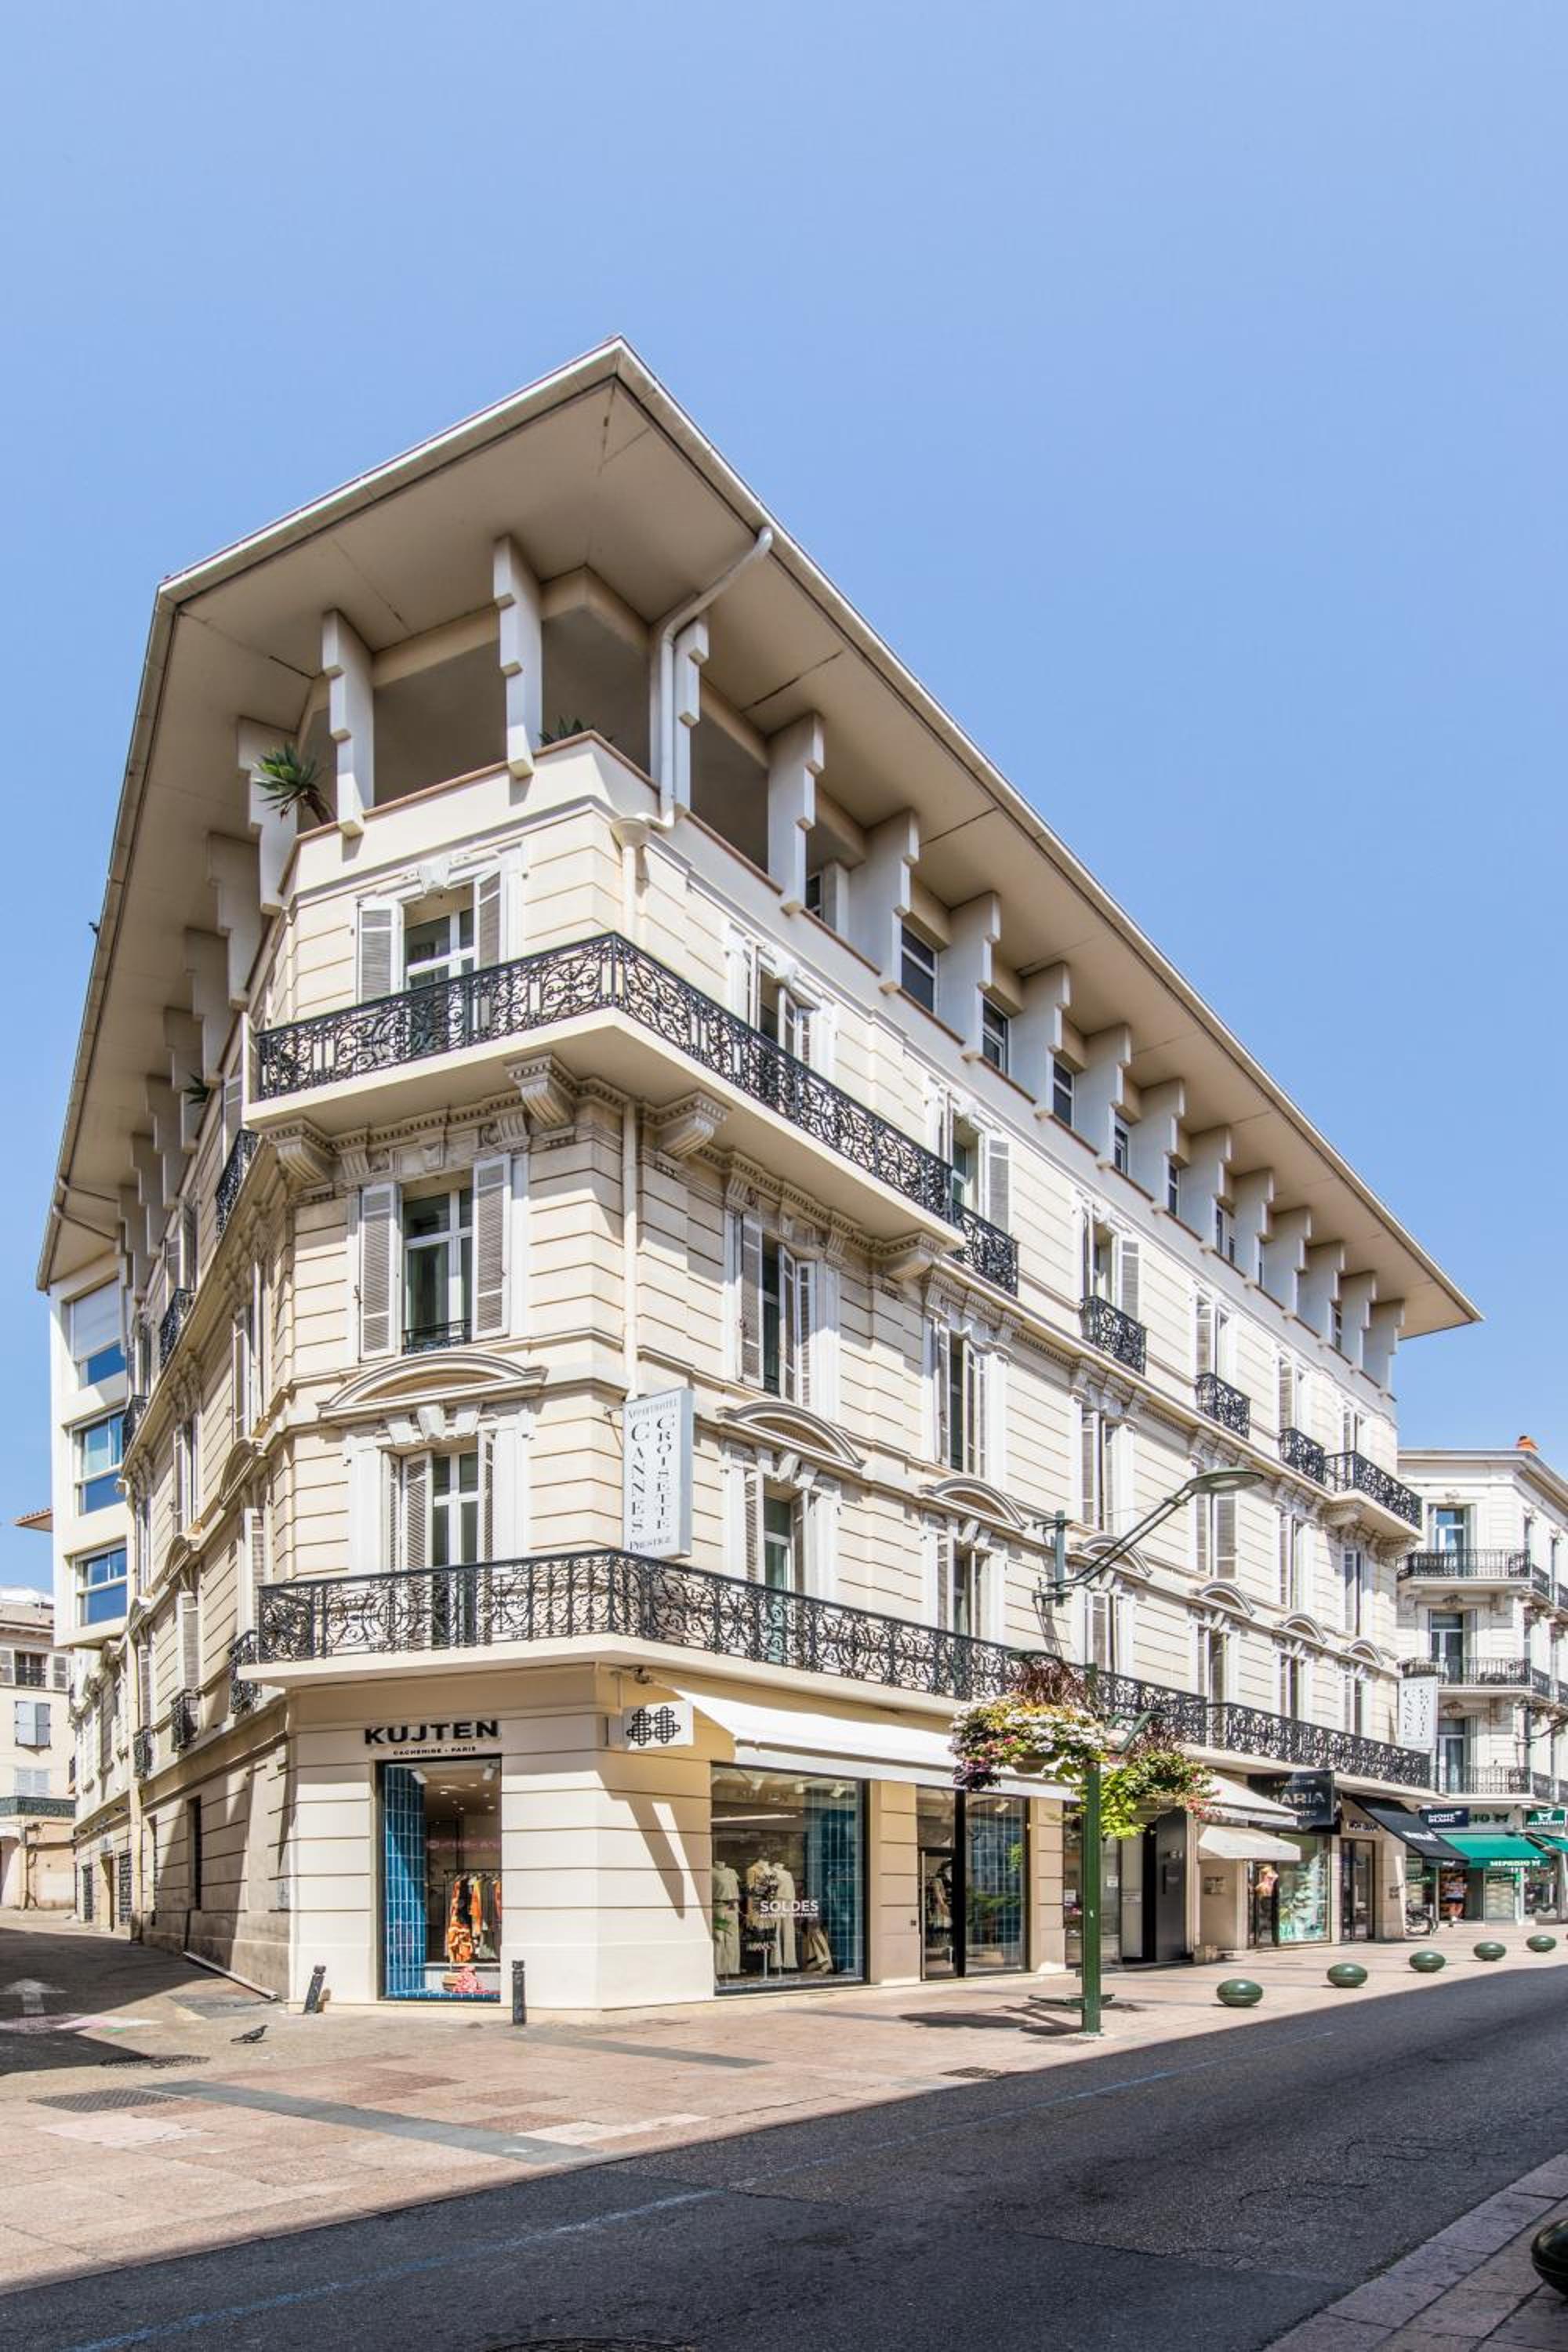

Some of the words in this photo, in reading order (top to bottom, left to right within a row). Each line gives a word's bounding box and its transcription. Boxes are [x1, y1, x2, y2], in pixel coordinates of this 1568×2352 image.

[631, 1421, 651, 1534] CANNES
[655, 1414, 676, 1530] CROISETTE
[364, 1720, 498, 1744] KUJTEN
[760, 1900, 819, 1912] SOLDES
